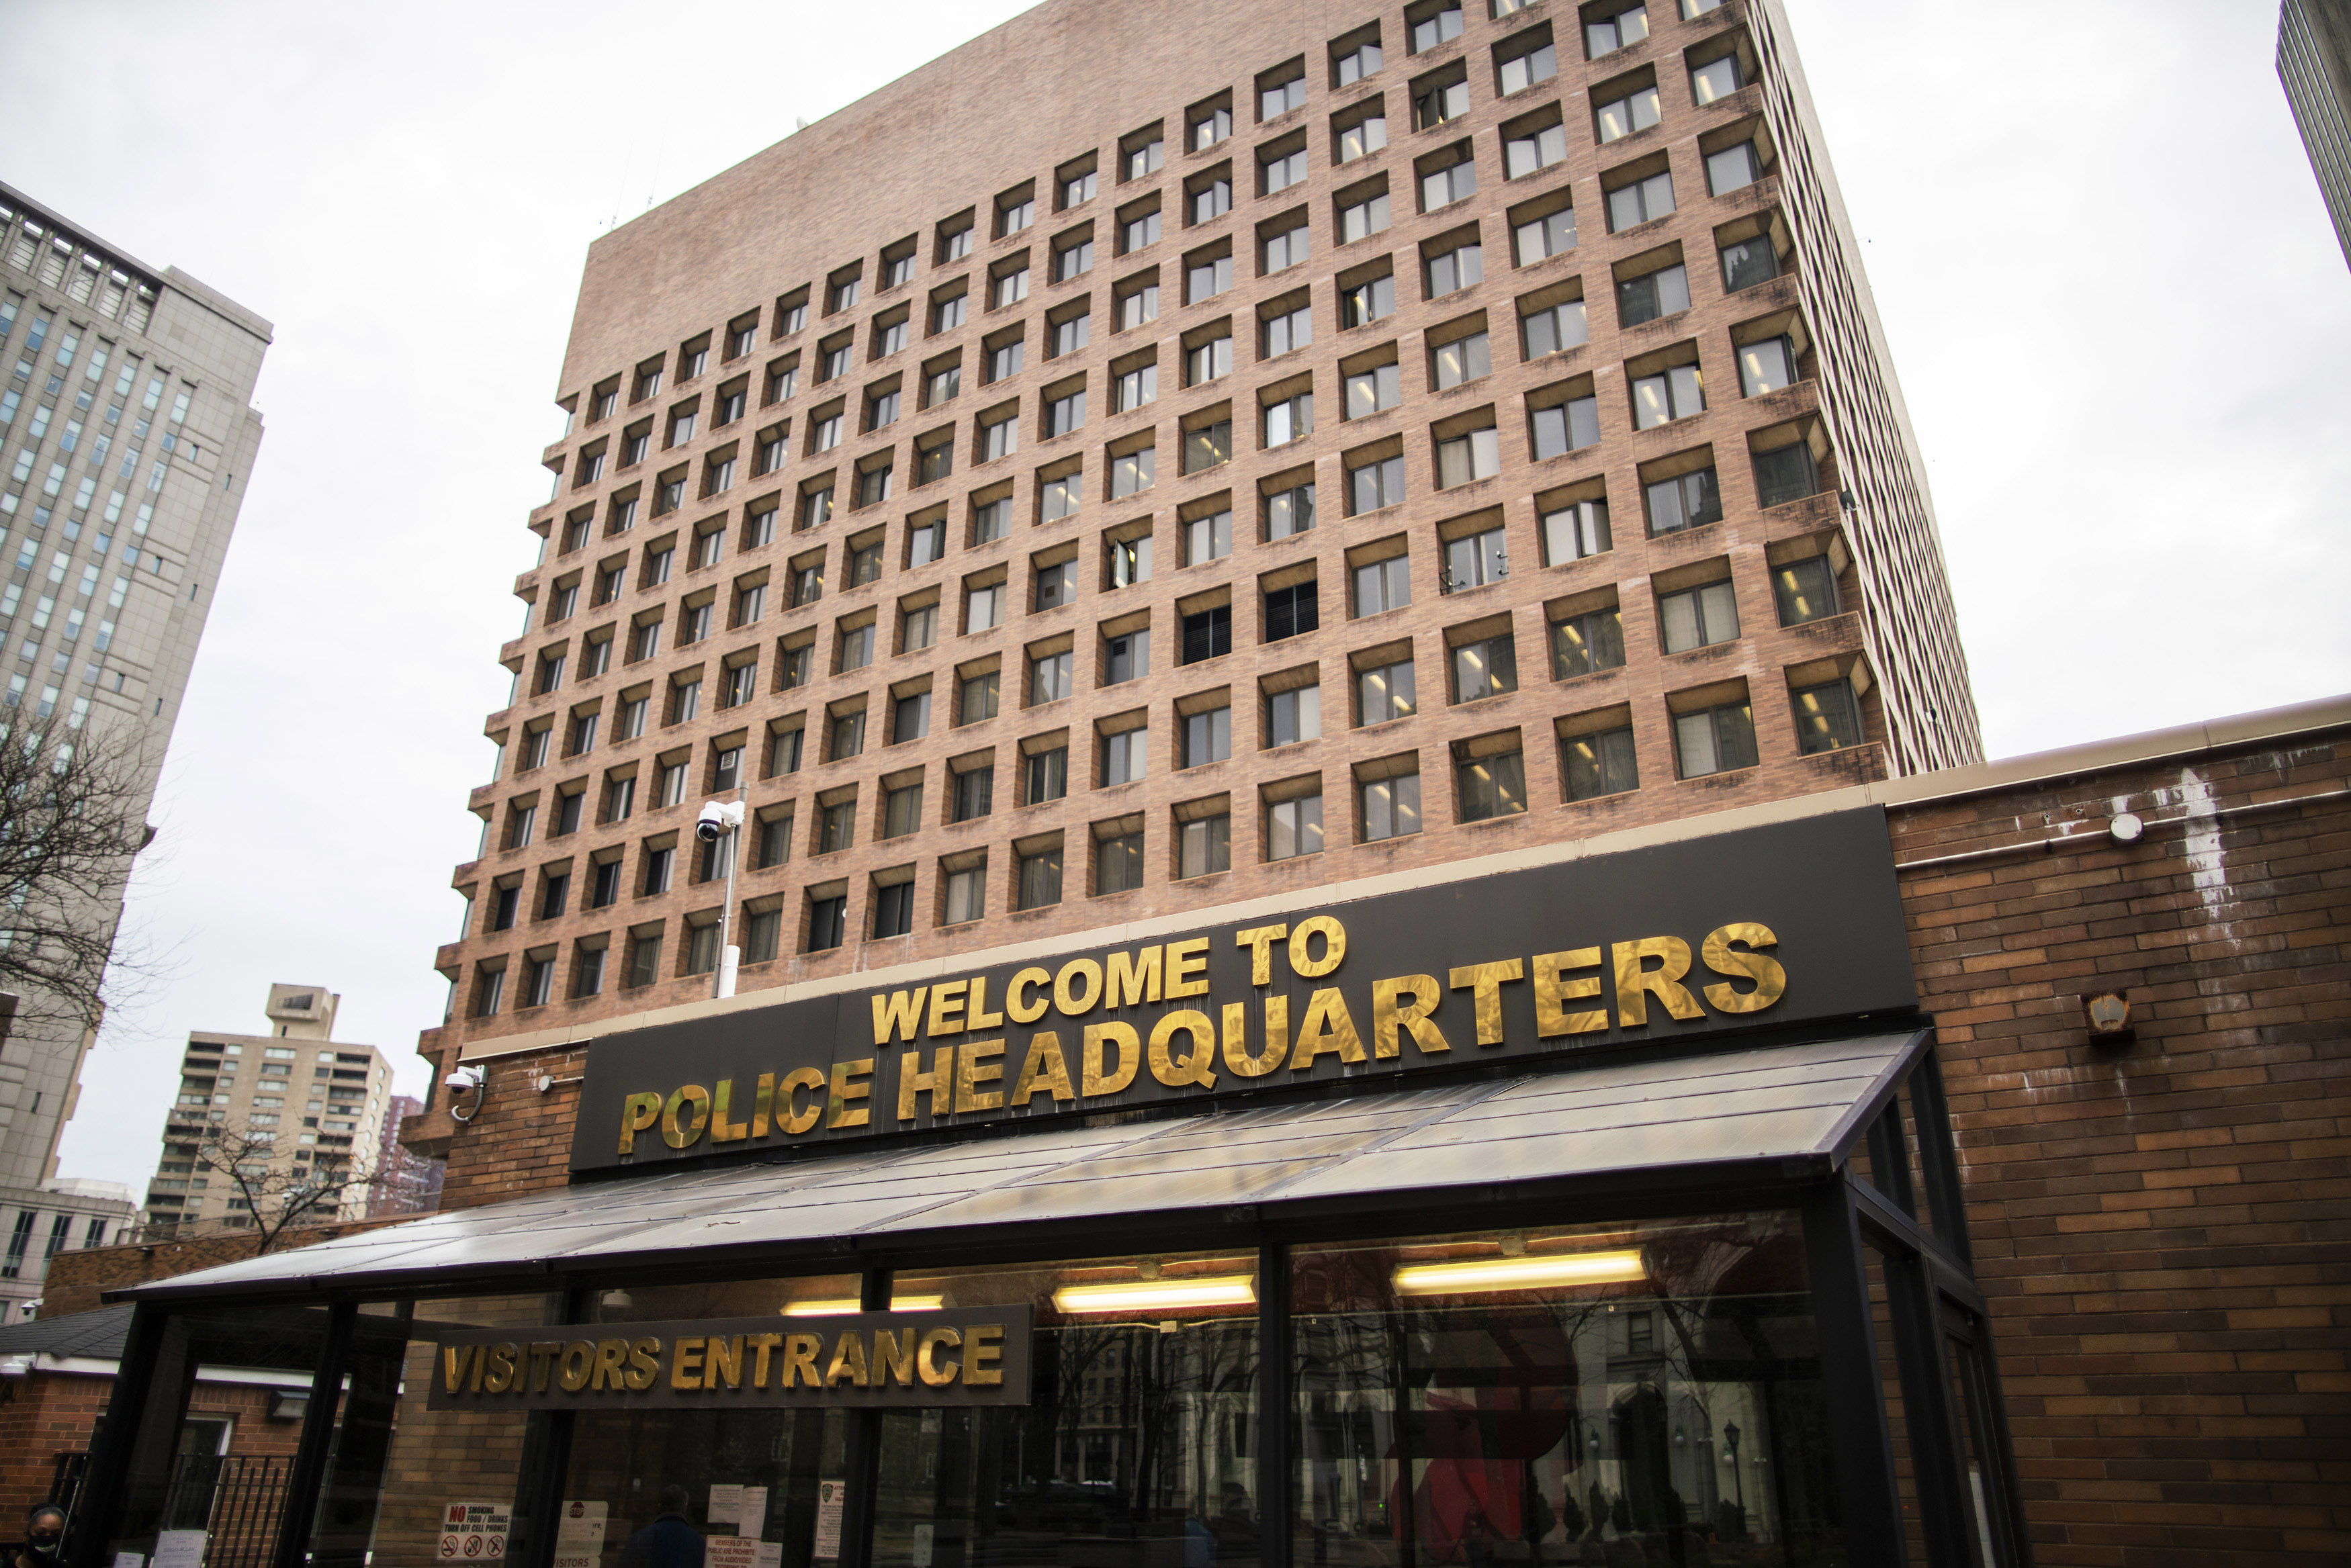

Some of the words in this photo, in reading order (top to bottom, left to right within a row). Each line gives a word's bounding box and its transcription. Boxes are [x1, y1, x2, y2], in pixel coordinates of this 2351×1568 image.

[871, 937, 1210, 1045] WELCOME
[1237, 916, 1347, 988] TO
[617, 1058, 875, 1155] POLICE
[896, 922, 1787, 1121] HEADQUARTERS
[443, 1336, 662, 1395] VISITORS
[671, 1324, 1008, 1393] ENTRANCE
[445, 1524, 459, 1532] TURN
[460, 1524, 471, 1532] OFF
[472, 1524, 484, 1532] CELL
[486, 1524, 508, 1532] PHONES
[449, 1506, 466, 1522] NO
[468, 1506, 495, 1514] SMOKING
[467, 1515, 482, 1523] FOOD
[488, 1515, 508, 1523] DRINKS
